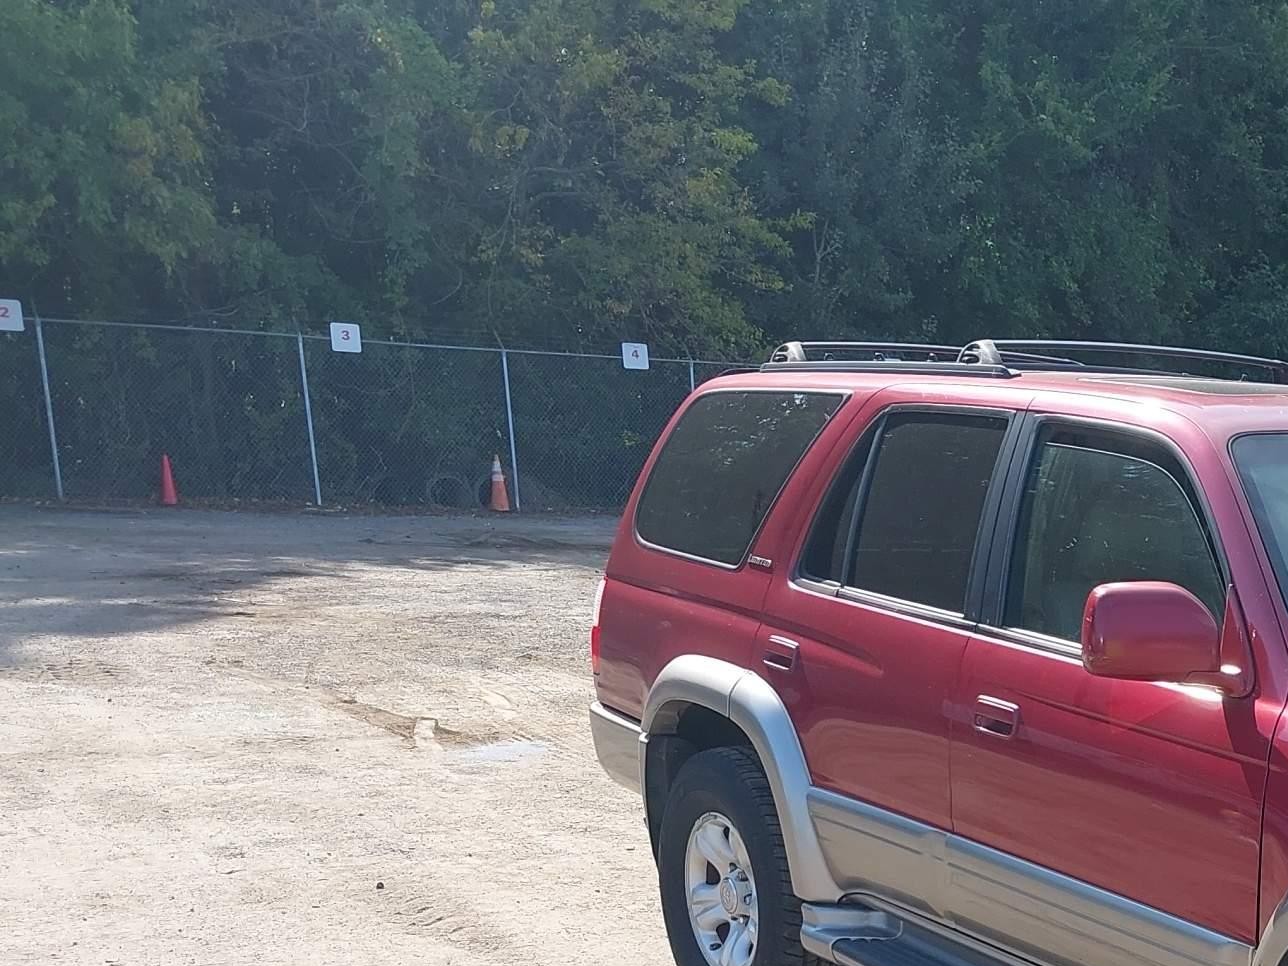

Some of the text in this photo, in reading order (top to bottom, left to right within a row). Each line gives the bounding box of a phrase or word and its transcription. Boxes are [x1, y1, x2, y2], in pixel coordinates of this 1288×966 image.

[0, 306, 9, 317] 2
[341, 330, 350, 341] 3
[631, 349, 640, 360] 4
